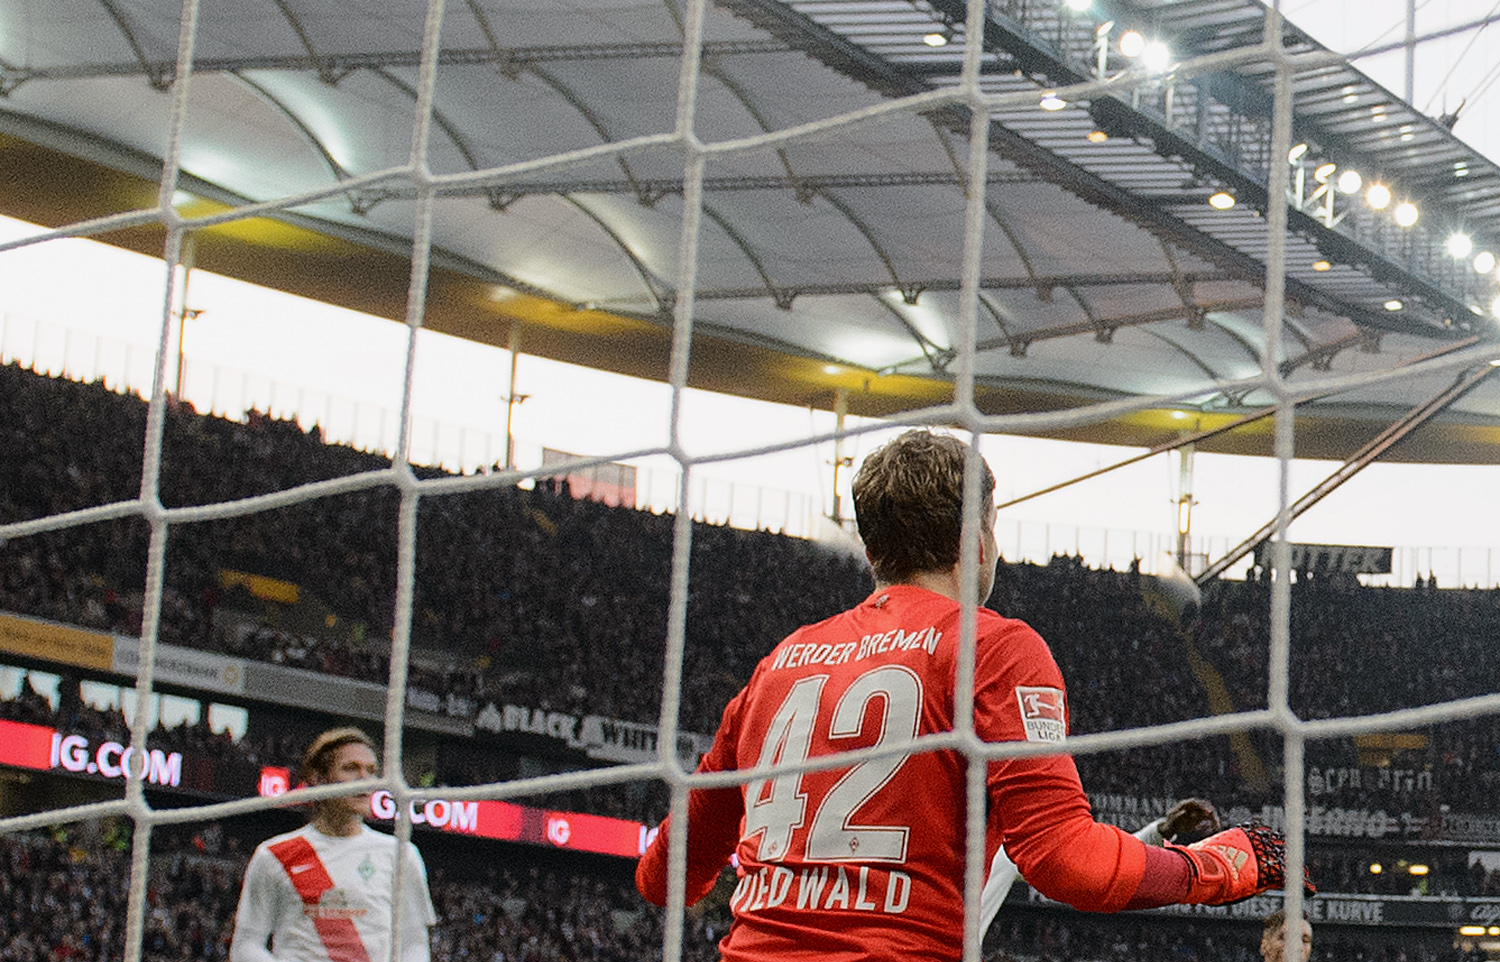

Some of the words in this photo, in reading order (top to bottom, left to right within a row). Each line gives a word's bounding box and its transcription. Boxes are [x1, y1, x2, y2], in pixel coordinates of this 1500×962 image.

[772, 640, 857, 672] WERDER
[857, 625, 943, 659] BREMEN
[601, 721, 672, 756] WHIT
[50, 732, 182, 788] IG.COM
[744, 664, 924, 865] 42
[370, 790, 479, 832] G.COM
[548, 819, 571, 845] IG
[1327, 901, 1385, 923] KURVE
